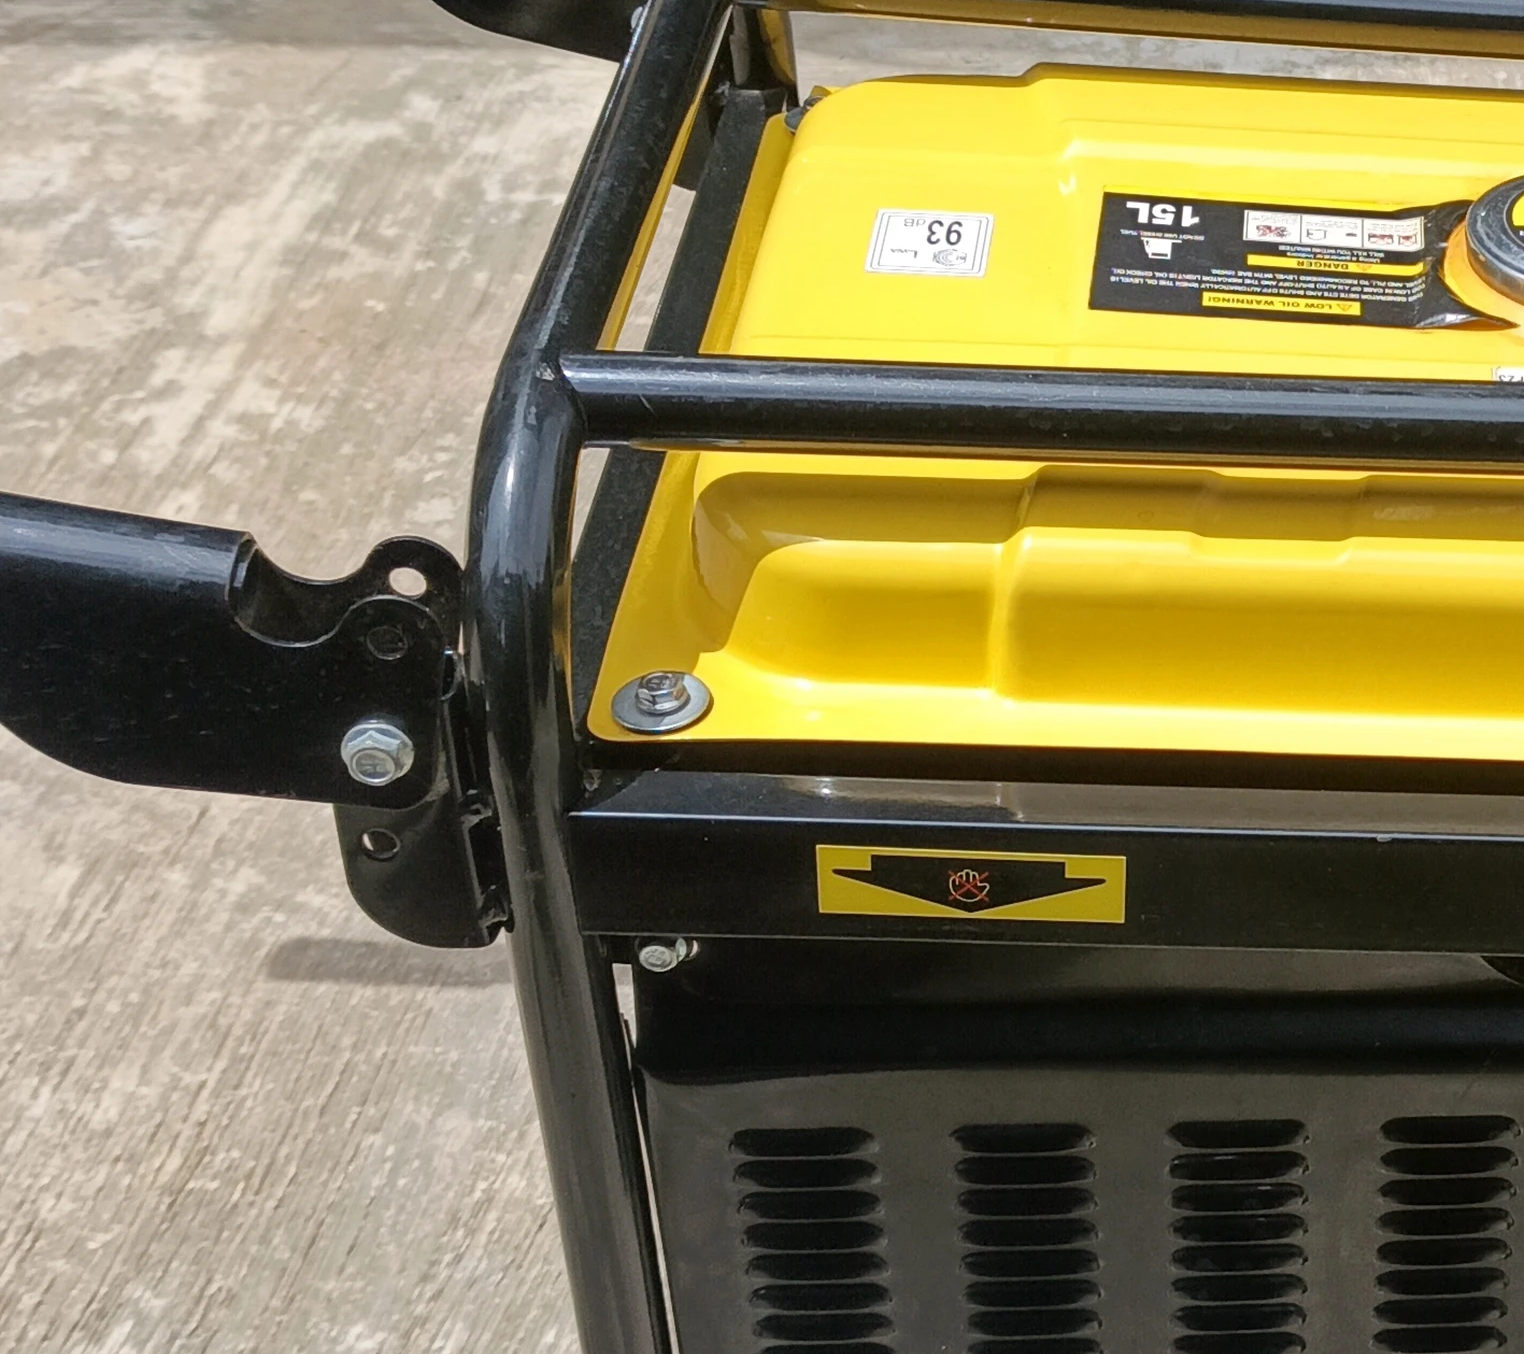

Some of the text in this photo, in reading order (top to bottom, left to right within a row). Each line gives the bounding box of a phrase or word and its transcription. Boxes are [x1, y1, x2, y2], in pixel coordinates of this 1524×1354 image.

[1126, 201, 1200, 228] 15L
[903, 217, 963, 246] 93 dB
[1297, 260, 1349, 270] DANGER
[1207, 296, 1275, 307] WARNING!
